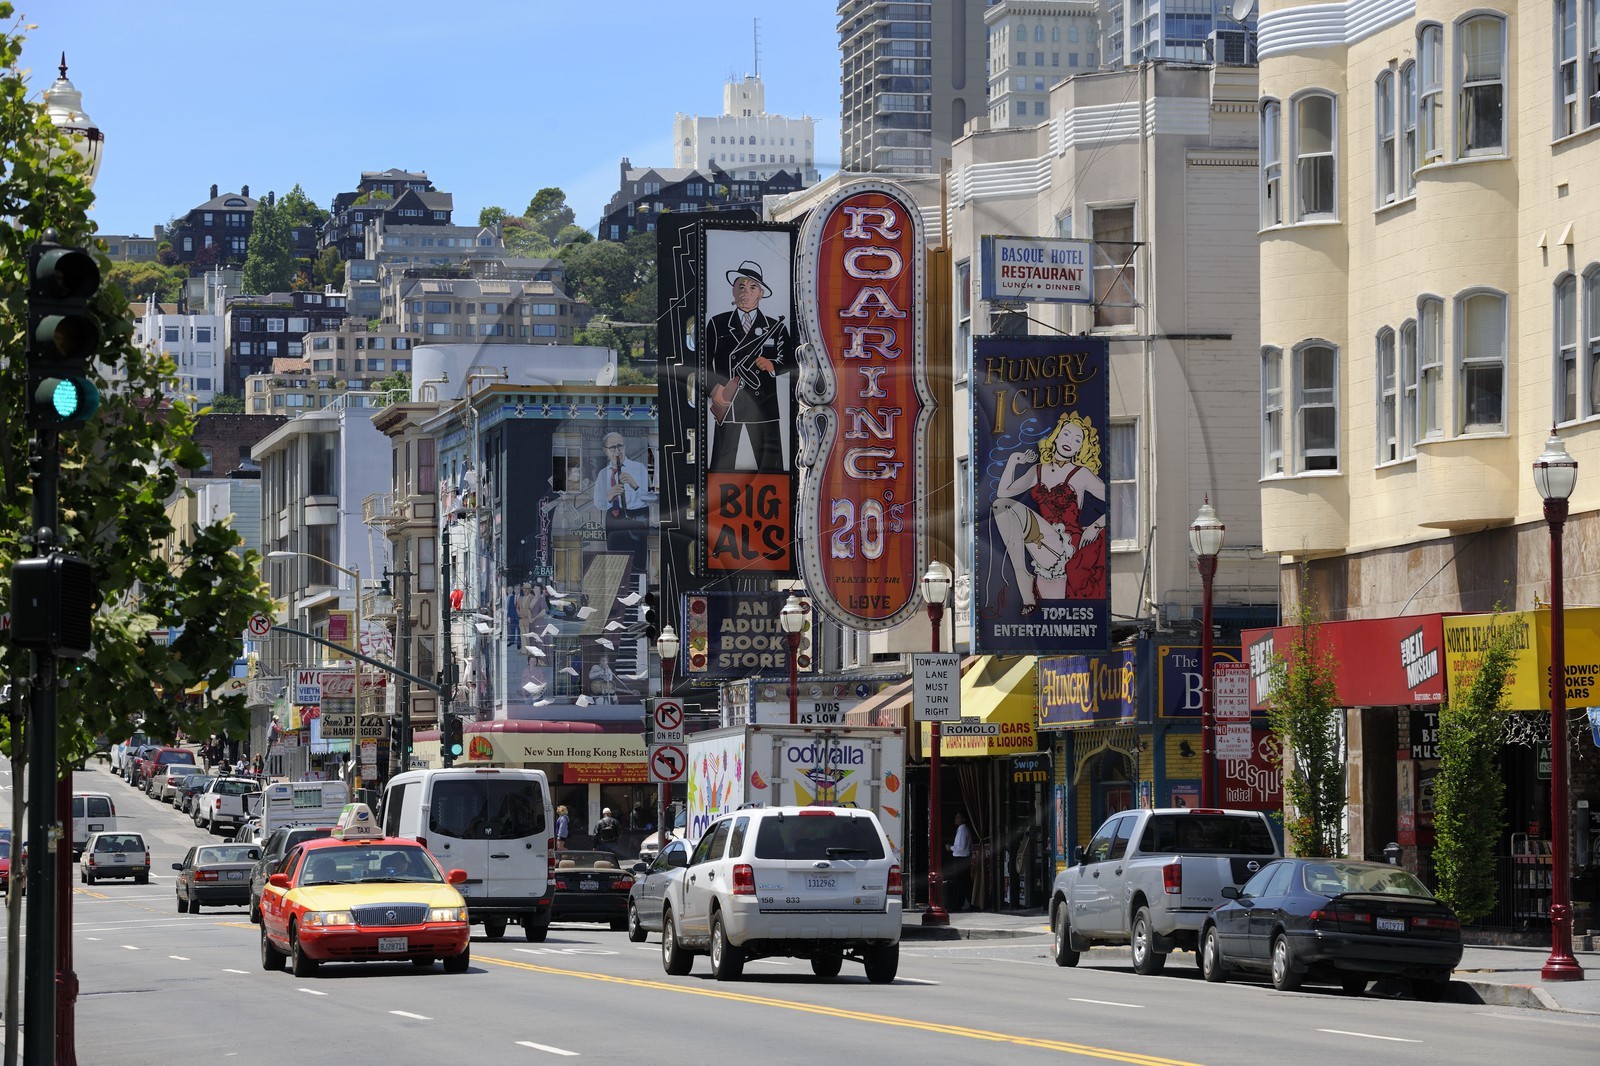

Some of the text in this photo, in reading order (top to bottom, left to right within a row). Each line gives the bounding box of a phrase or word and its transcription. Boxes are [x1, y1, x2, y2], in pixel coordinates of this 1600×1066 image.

[1001, 246, 1084, 265] BASQUE HOTEL
[1001, 265, 1084, 281] RESTAURANT
[1045, 283, 1081, 291] DINNER
[839, 206, 907, 481] ROARING
[984, 352, 1097, 385] HUNGRY
[993, 384, 1078, 434] I CLUB
[719, 483, 782, 520] BIG
[709, 520, 786, 561] AL'S
[835, 576, 880, 584] PLAYBOY
[849, 595, 891, 609] LOVE
[737, 602, 768, 616] AN
[1041, 607, 1094, 620] TOPLESS
[994, 624, 1098, 637] ENTERTAINMENT
[721, 636, 785, 651] BOOK
[1446, 627, 1471, 653] NORTH
[1405, 631, 1424, 663] BEAT
[719, 653, 786, 668] STORE
[915, 658, 959, 666] TOW-AWAY
[1171, 654, 1198, 668] The
[925, 671, 948, 679] LANE
[1406, 650, 1438, 689] MUSEUM
[1547, 665, 1600, 676] SNDWIC
[299, 672, 316, 685] MY
[1548, 676, 1595, 688] SOKES
[1041, 667, 1092, 718] HUNGRY
[814, 703, 840, 712] DVDS
[925, 708, 949, 716] RIGHT
[322, 715, 343, 727] Sam's
[801, 714, 813, 724] AS
[817, 713, 837, 724] LOW
[946, 725, 996, 734] ROMOLO
[1001, 722, 1031, 734] GARS
[1216, 725, 1249, 735] NO PARKING
[657, 731, 681, 740] ON RED
[988, 736, 994, 748] &
[997, 736, 1033, 748] LIQUORS
[1421, 728, 1438, 743] BE
[524, 747, 545, 757] New
[546, 747, 564, 757] Sun
[567, 747, 592, 759] Hong
[593, 747, 618, 759] Kong
[787, 744, 864, 765] odwalla
[1412, 745, 1441, 758] MUS
[1014, 758, 1039, 769] Swipe
[1014, 771, 1047, 783] ATM
[1226, 787, 1253, 802] hotel
[808, 879, 836, 888] 1312962
[786, 896, 801, 904] 833
